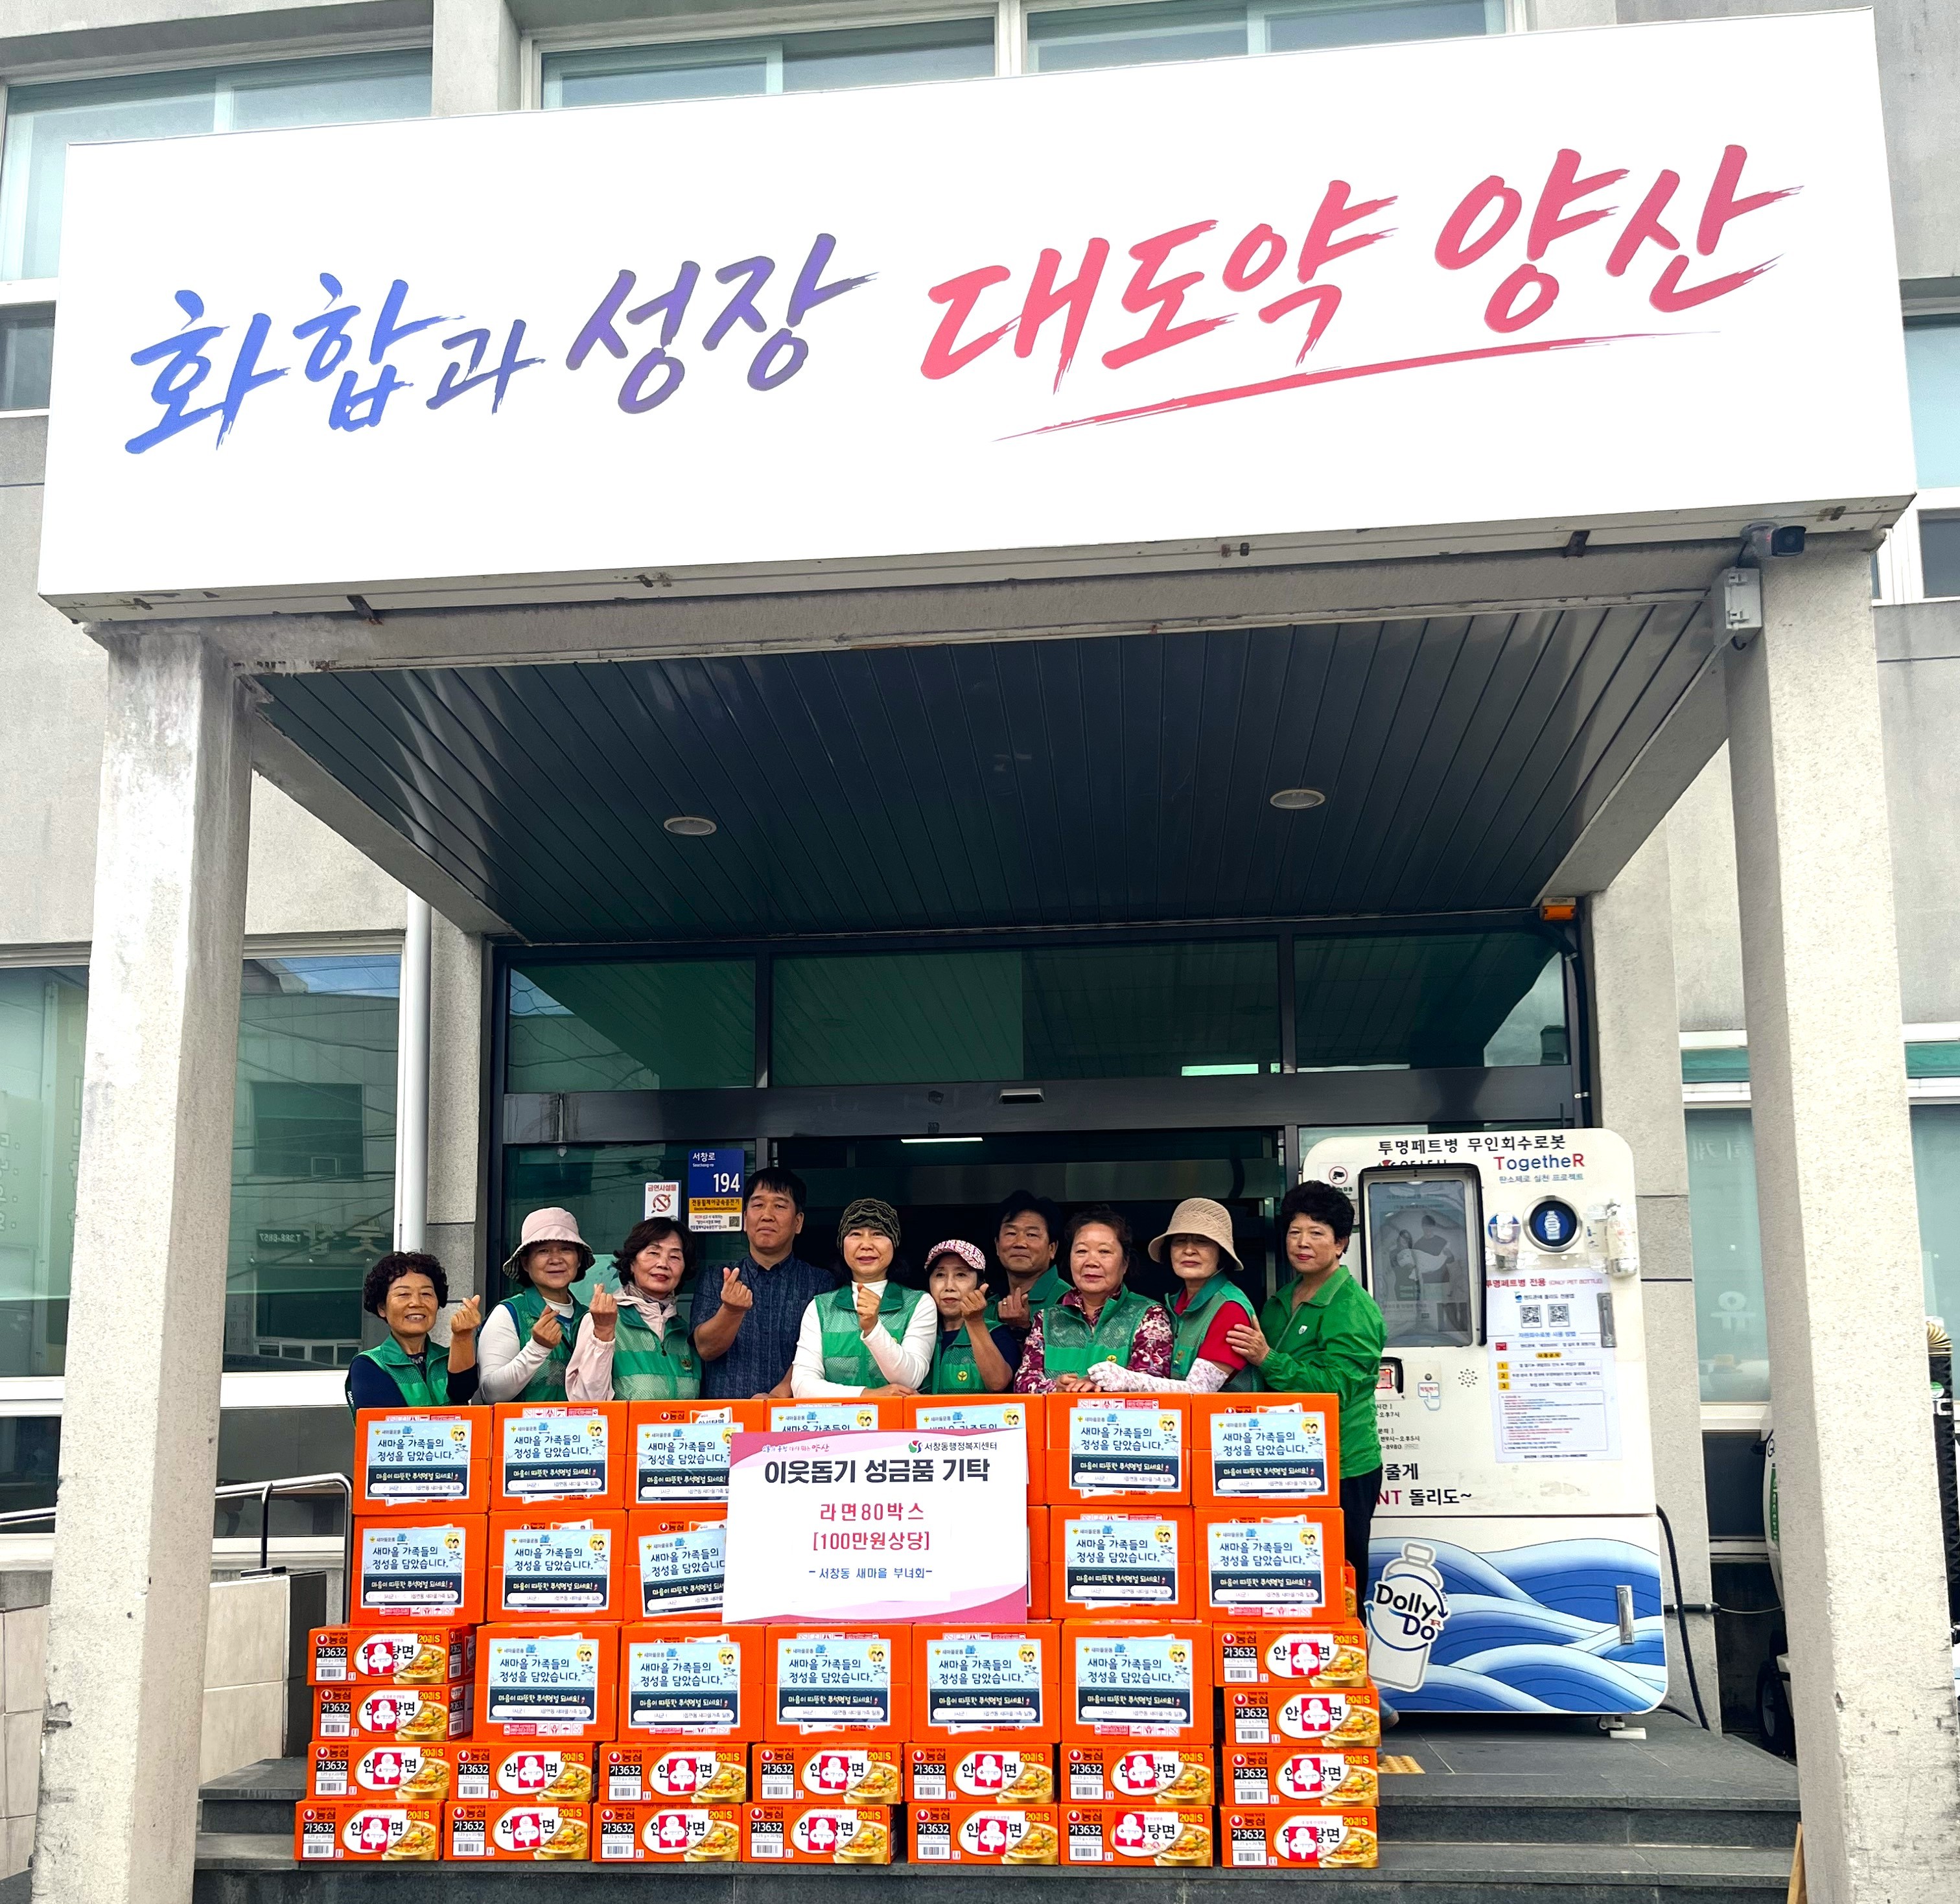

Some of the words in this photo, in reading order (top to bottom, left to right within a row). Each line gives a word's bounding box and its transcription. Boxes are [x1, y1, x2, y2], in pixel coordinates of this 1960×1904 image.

[125, 272, 546, 455] 화합과
[566, 232, 880, 415] 성장
[920, 179, 1399, 396] 대도약
[1434, 144, 1804, 334] 양산
[1378, 1139, 1458, 1155] 투명페트병
[1467, 1134, 1566, 1152] 무인회수로봇
[692, 1152, 716, 1162] 서창로
[1493, 1152, 1585, 1171] TogetheR
[713, 1172, 740, 1192] 194
[1499, 1174, 1531, 1184] 탄소제로
[1534, 1174, 1550, 1183] 실천
[1552, 1172, 1583, 1181] 프로젝트
[1486, 1279, 1526, 1288] 투명페트병
[1530, 1278, 1546, 1287] 전용
[1081, 1426, 1110, 1438] 새마을
[1114, 1428, 1152, 1439] 가족들의
[1223, 1432, 1252, 1443] 새마을
[1256, 1432, 1295, 1443] 가족들의
[378, 1439, 405, 1450] 새마을
[408, 1439, 444, 1449] 가족들의
[515, 1435, 542, 1446] 새마을
[544, 1435, 581, 1445] 가족들의
[924, 1441, 997, 1451] 서창동행정복지센터
[1081, 1439, 1109, 1450] 정성을
[1113, 1440, 1163, 1452] 담았습니다.
[514, 1448, 541, 1459] 정성을
[544, 1446, 592, 1457] 담았습니다.
[648, 1442, 676, 1453] 새마을
[679, 1442, 716, 1452] 가족들의
[1223, 1445, 1252, 1456] 정성을
[1256, 1445, 1308, 1456] 담았습니다.
[377, 1452, 404, 1461] 정성을
[407, 1451, 454, 1461] 담았습니다.
[648, 1454, 675, 1465] 정성을
[679, 1454, 727, 1465] 담았습니다.
[765, 1459, 856, 1483] 이웃돕기
[864, 1459, 934, 1483] 성금품
[942, 1458, 990, 1482] 기탁
[1384, 1463, 1418, 1481] 줄게
[1408, 1488, 1472, 1506] 돌리도~
[820, 1502, 925, 1522] 라면80박스
[813, 1531, 930, 1551] [100만원상당]
[1077, 1538, 1106, 1550] 새마을
[1109, 1539, 1148, 1550] 가족들의
[373, 1547, 400, 1557] 새마을
[402, 1546, 438, 1557] 가족들의
[1220, 1542, 1250, 1553] 새마을
[1253, 1542, 1292, 1553] 가족들의
[515, 1548, 542, 1559] 새마을
[546, 1548, 583, 1559] 가족들의
[651, 1551, 679, 1564] 새마을
[682, 1548, 719, 1561] 가족들의
[1077, 1552, 1105, 1563] 정성을
[1109, 1552, 1160, 1564] 담았습니다.
[373, 1559, 399, 1570] 정성을
[402, 1559, 449, 1569] 담았습니다.
[515, 1561, 542, 1571] 정성을
[545, 1561, 594, 1571] 담았습니다.
[1220, 1555, 1249, 1566] 정성을
[1253, 1555, 1305, 1566] 담았습니다.
[651, 1564, 679, 1577] 정성을
[856, 1567, 887, 1579] 새마을
[1374, 1583, 1437, 1621] Dolly
[1402, 1615, 1436, 1640] Do
[317, 1647, 346, 1657] 가3632
[1224, 1647, 1256, 1657] 가3632
[500, 1658, 529, 1669] 새마을
[531, 1658, 570, 1669] 가족들의
[641, 1662, 670, 1674] 새마을
[673, 1662, 711, 1673] 가족들의
[789, 1658, 819, 1670] 새마을
[822, 1659, 861, 1670] 가족들의
[939, 1660, 968, 1671] 새마을
[972, 1660, 1011, 1671] 가족들의
[1088, 1658, 1118, 1669] 새마을
[1121, 1658, 1161, 1671] 가족들의
[500, 1671, 528, 1682] 정성을
[531, 1671, 581, 1683] 담았습니다.
[640, 1676, 669, 1687] 정성을
[673, 1675, 723, 1686] 담았습니다.
[789, 1672, 818, 1683] 정성을
[822, 1672, 873, 1684] 담았습니다.
[939, 1673, 968, 1684] 정성을
[972, 1673, 1024, 1684] 담았습니다.
[1088, 1671, 1117, 1683] 정성을
[1121, 1672, 1174, 1684] 담았습니다.
[321, 1703, 350, 1713] 가3632
[1236, 1708, 1267, 1718] 가3632
[1285, 1705, 1342, 1721] 안면
[317, 1761, 347, 1770] 가3632
[459, 1764, 489, 1774] 가3632
[610, 1765, 640, 1776] 가3632
[763, 1764, 793, 1774] 가3632
[915, 1764, 945, 1774] 가3632
[1071, 1764, 1102, 1774] 가3632
[1235, 1769, 1266, 1778] 가3632
[305, 1823, 334, 1833] 가3632
[454, 1821, 484, 1831] 가3632
[603, 1823, 633, 1833] 가3632
[752, 1822, 782, 1833] 가3632
[918, 1824, 949, 1834] 가3632
[1069, 1825, 1101, 1835] 가3632
[1233, 1829, 1265, 1840] 가3632
